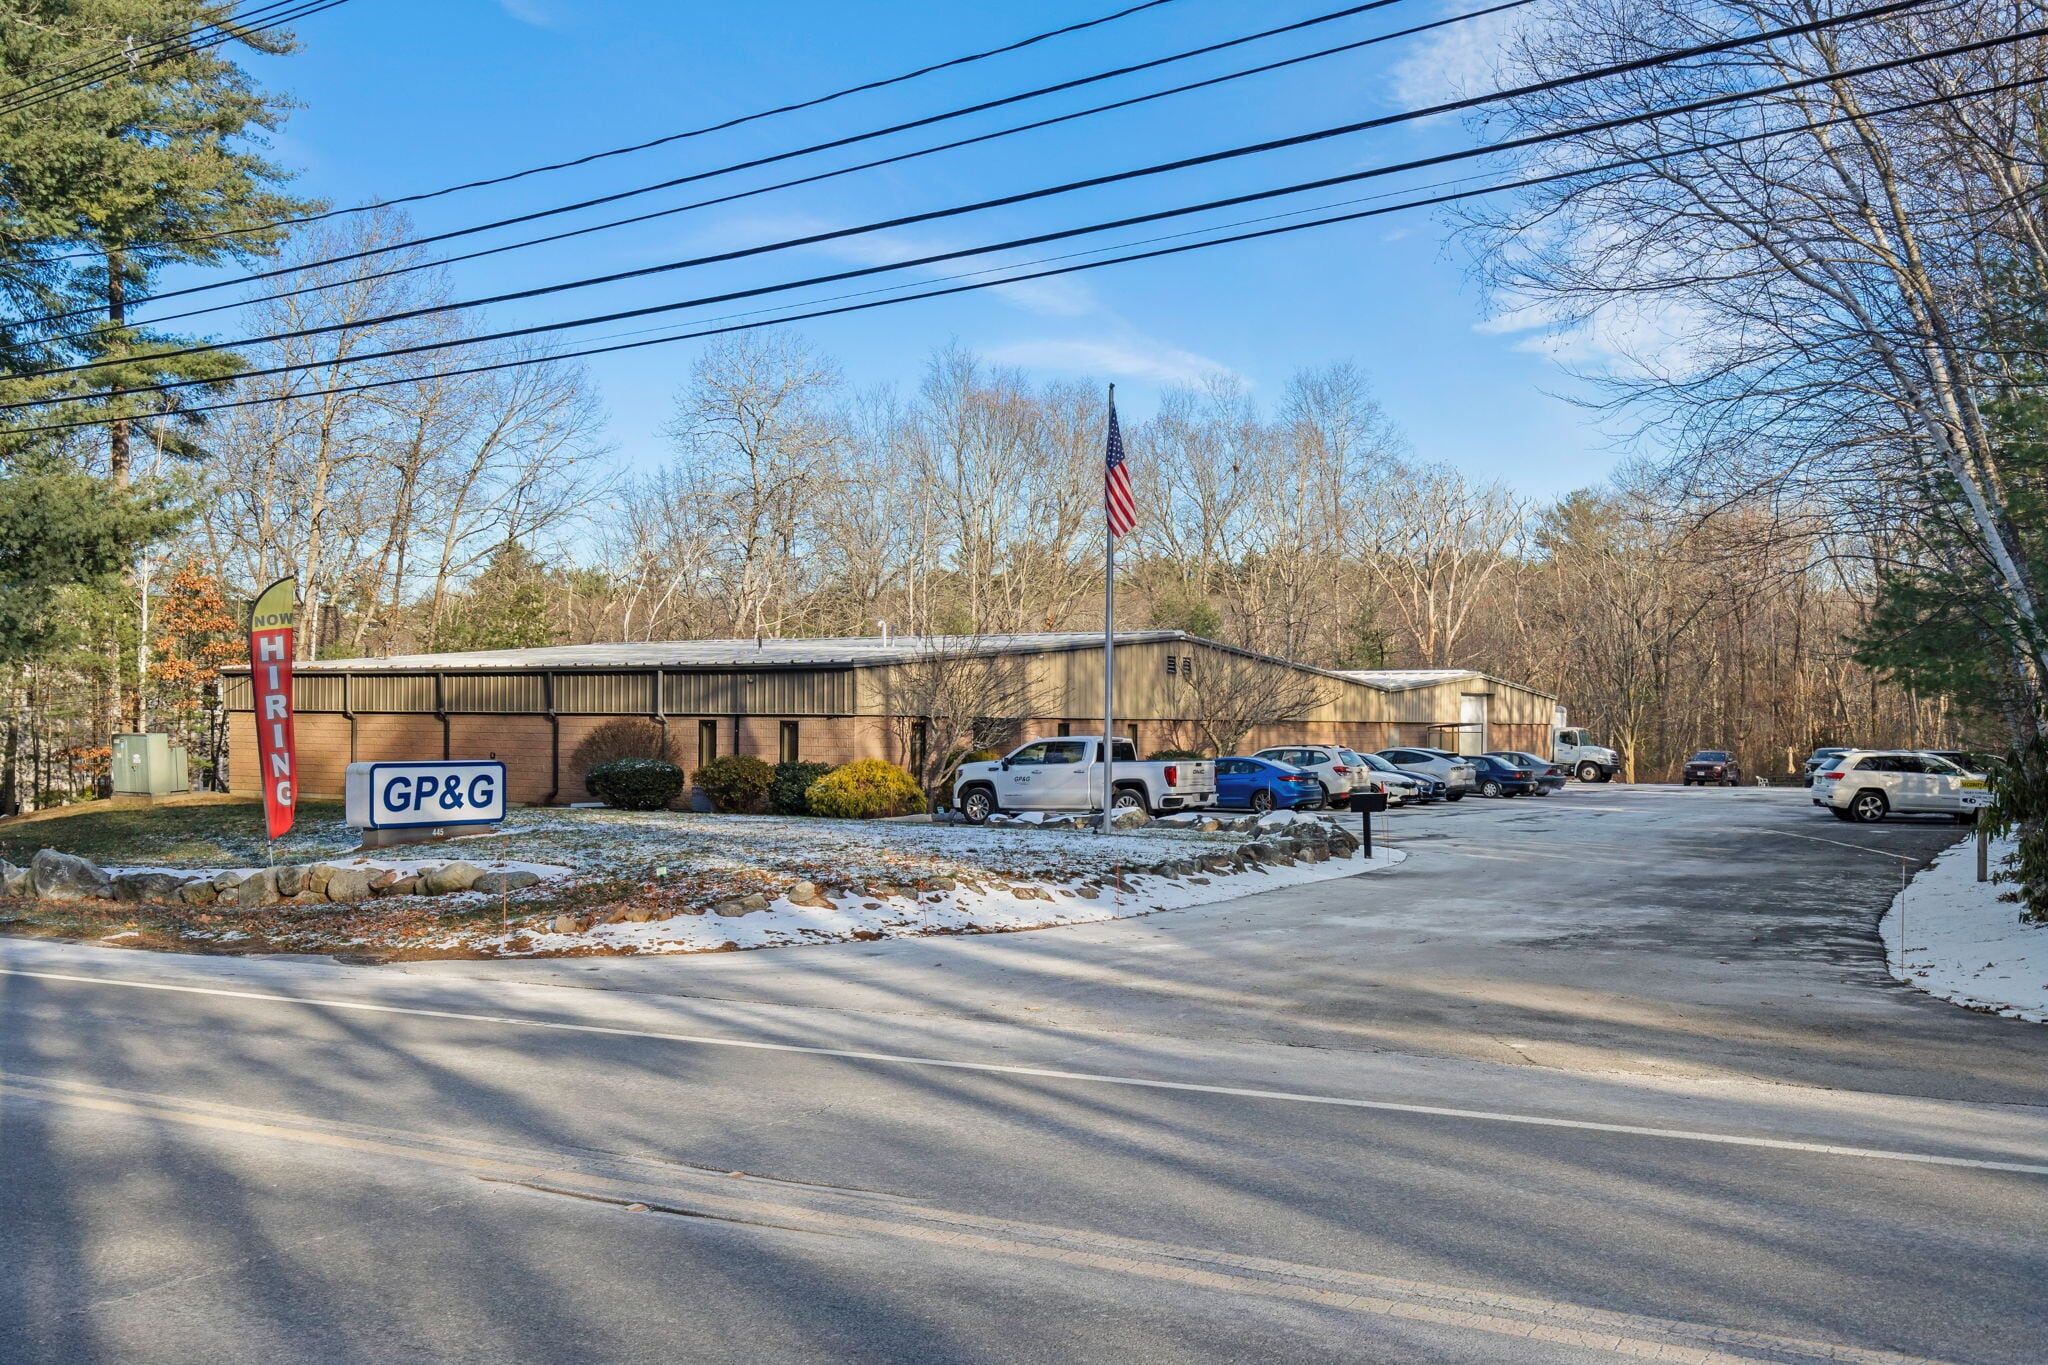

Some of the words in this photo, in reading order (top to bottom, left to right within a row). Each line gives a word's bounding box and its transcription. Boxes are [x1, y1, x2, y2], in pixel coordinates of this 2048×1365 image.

[254, 614, 292, 627] NOW
[259, 635, 292, 806] HIRING
[383, 774, 494, 812] GP&G
[432, 828, 444, 836] 445
